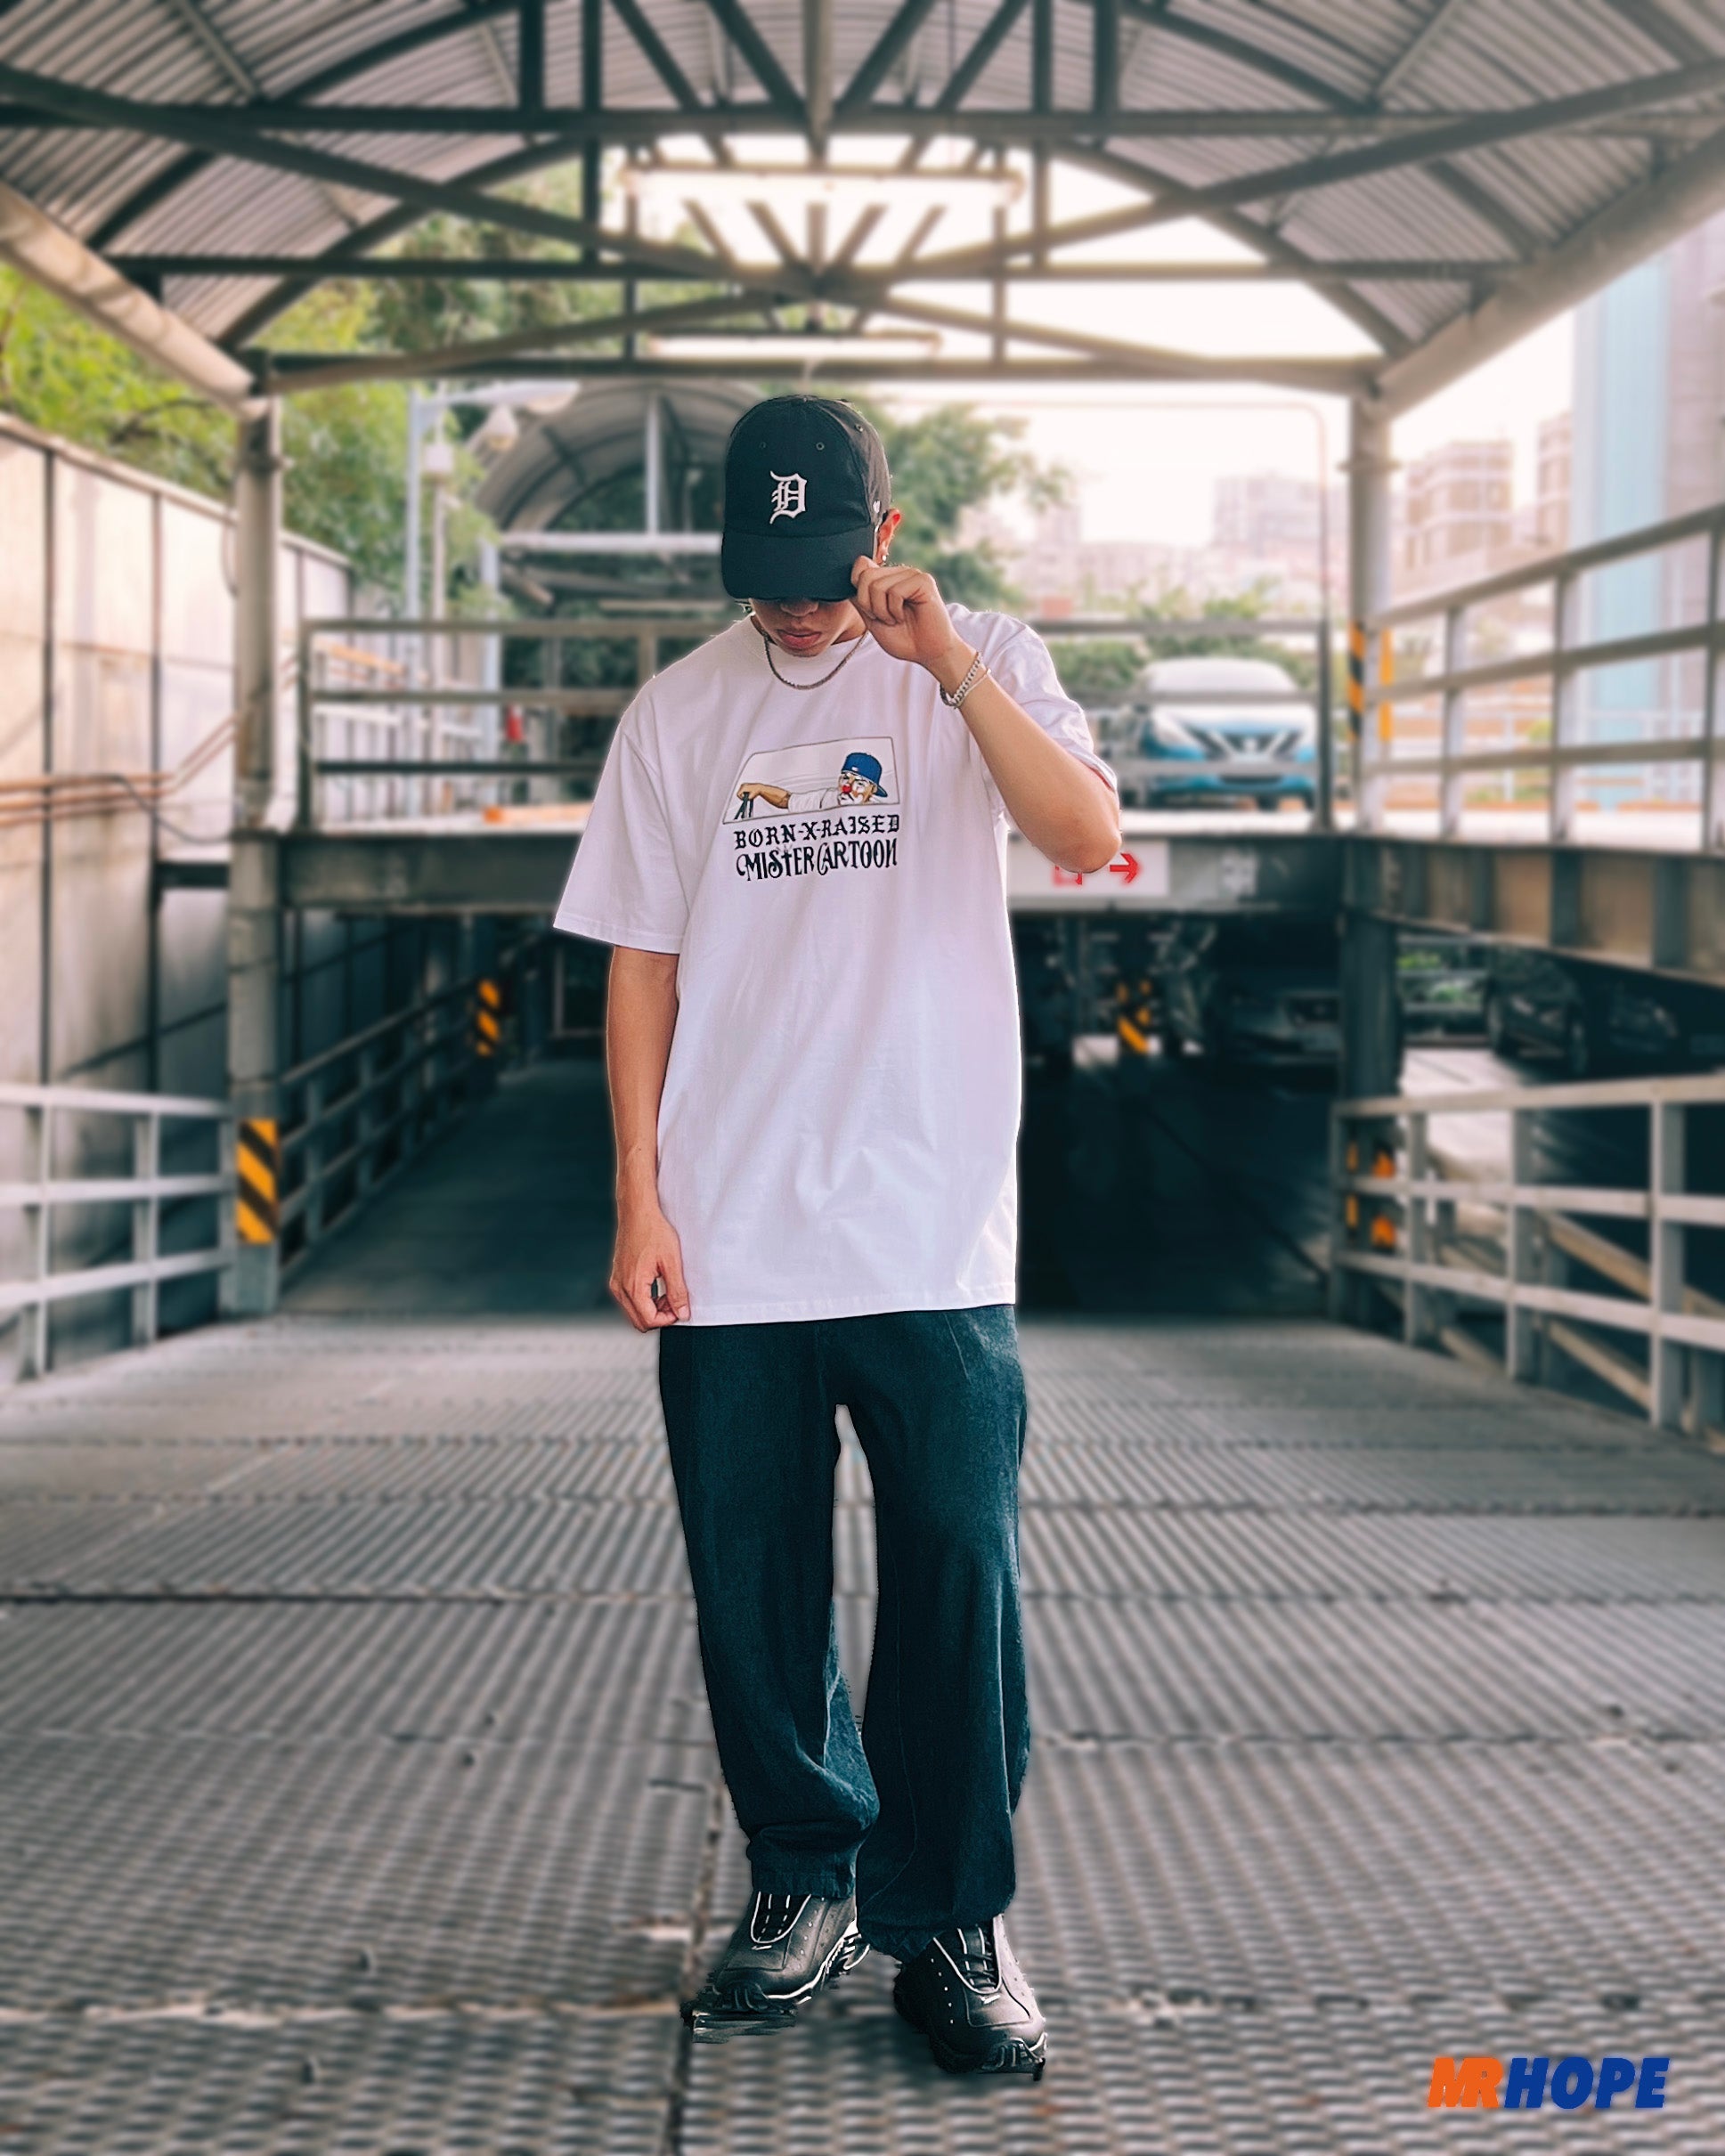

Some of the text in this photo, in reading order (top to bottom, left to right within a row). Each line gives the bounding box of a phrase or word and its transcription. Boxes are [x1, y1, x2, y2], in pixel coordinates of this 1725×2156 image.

[769, 470, 808, 525] D
[736, 838, 898, 881] MISTER CARTOON
